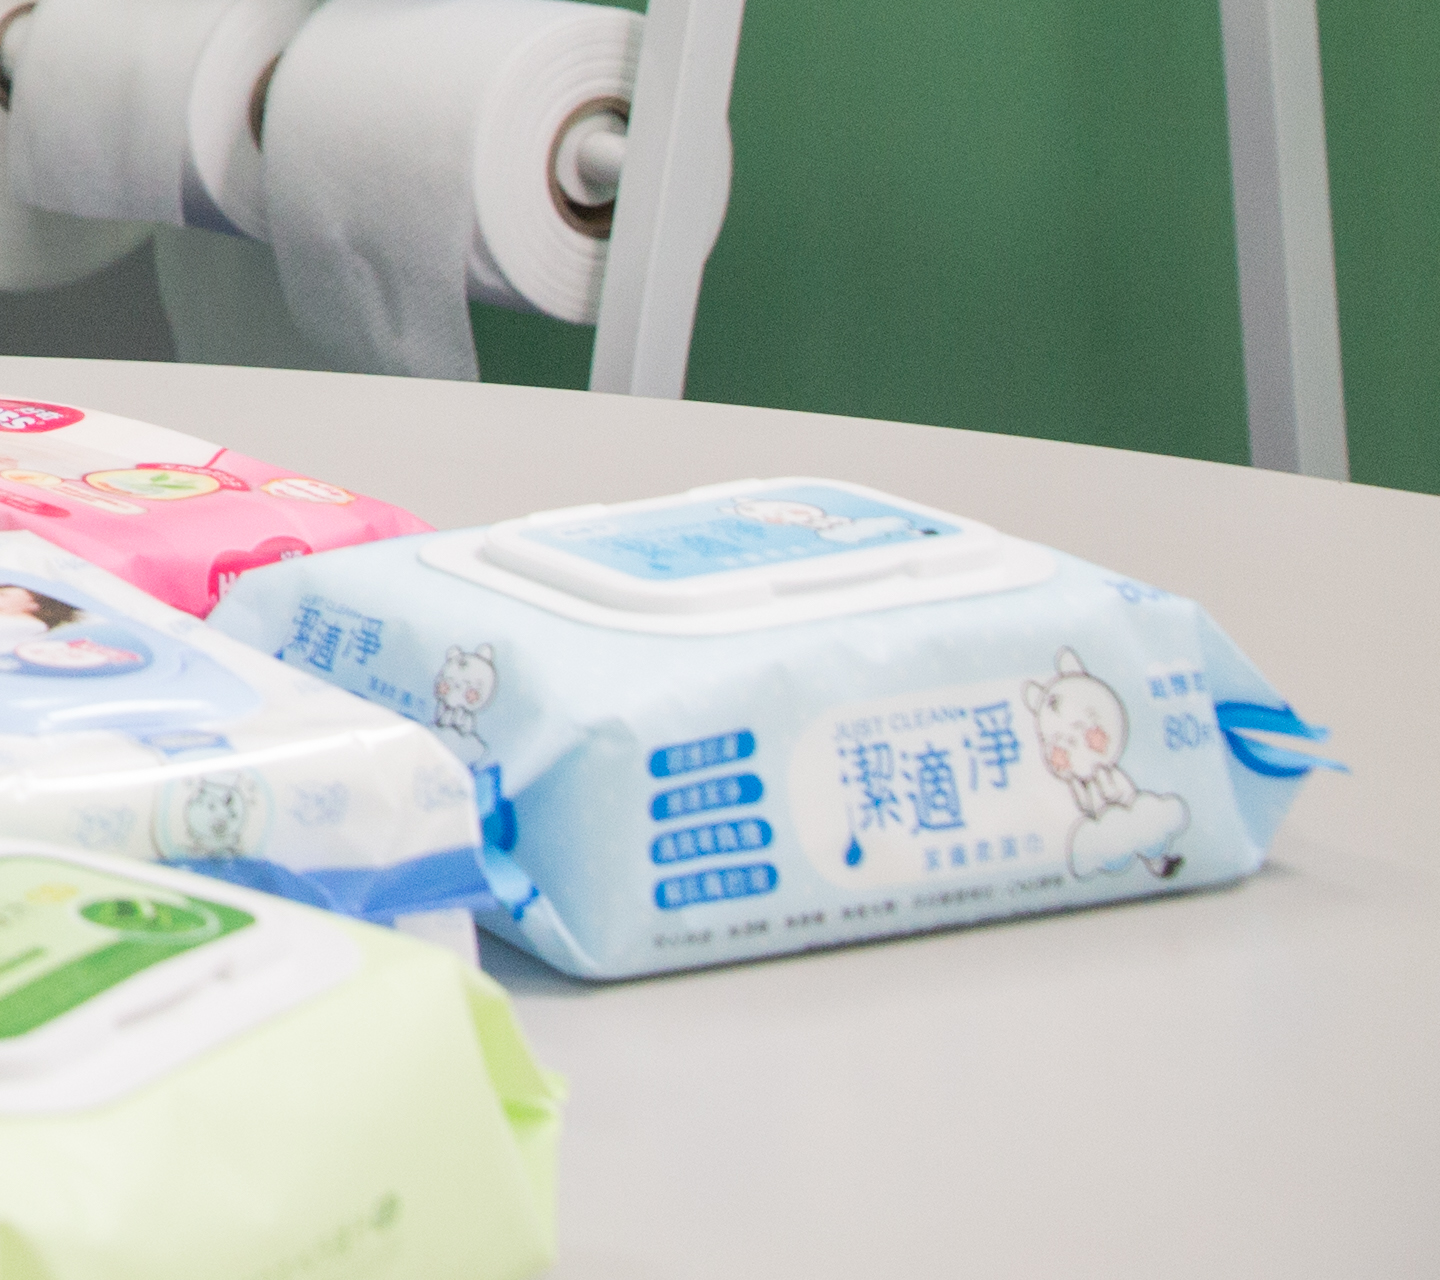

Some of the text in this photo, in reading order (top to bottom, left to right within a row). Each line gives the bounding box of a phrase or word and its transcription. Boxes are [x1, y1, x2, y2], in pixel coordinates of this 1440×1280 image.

[834, 704, 956, 739] JUST CLEAN
[1164, 711, 1200, 753] 80
